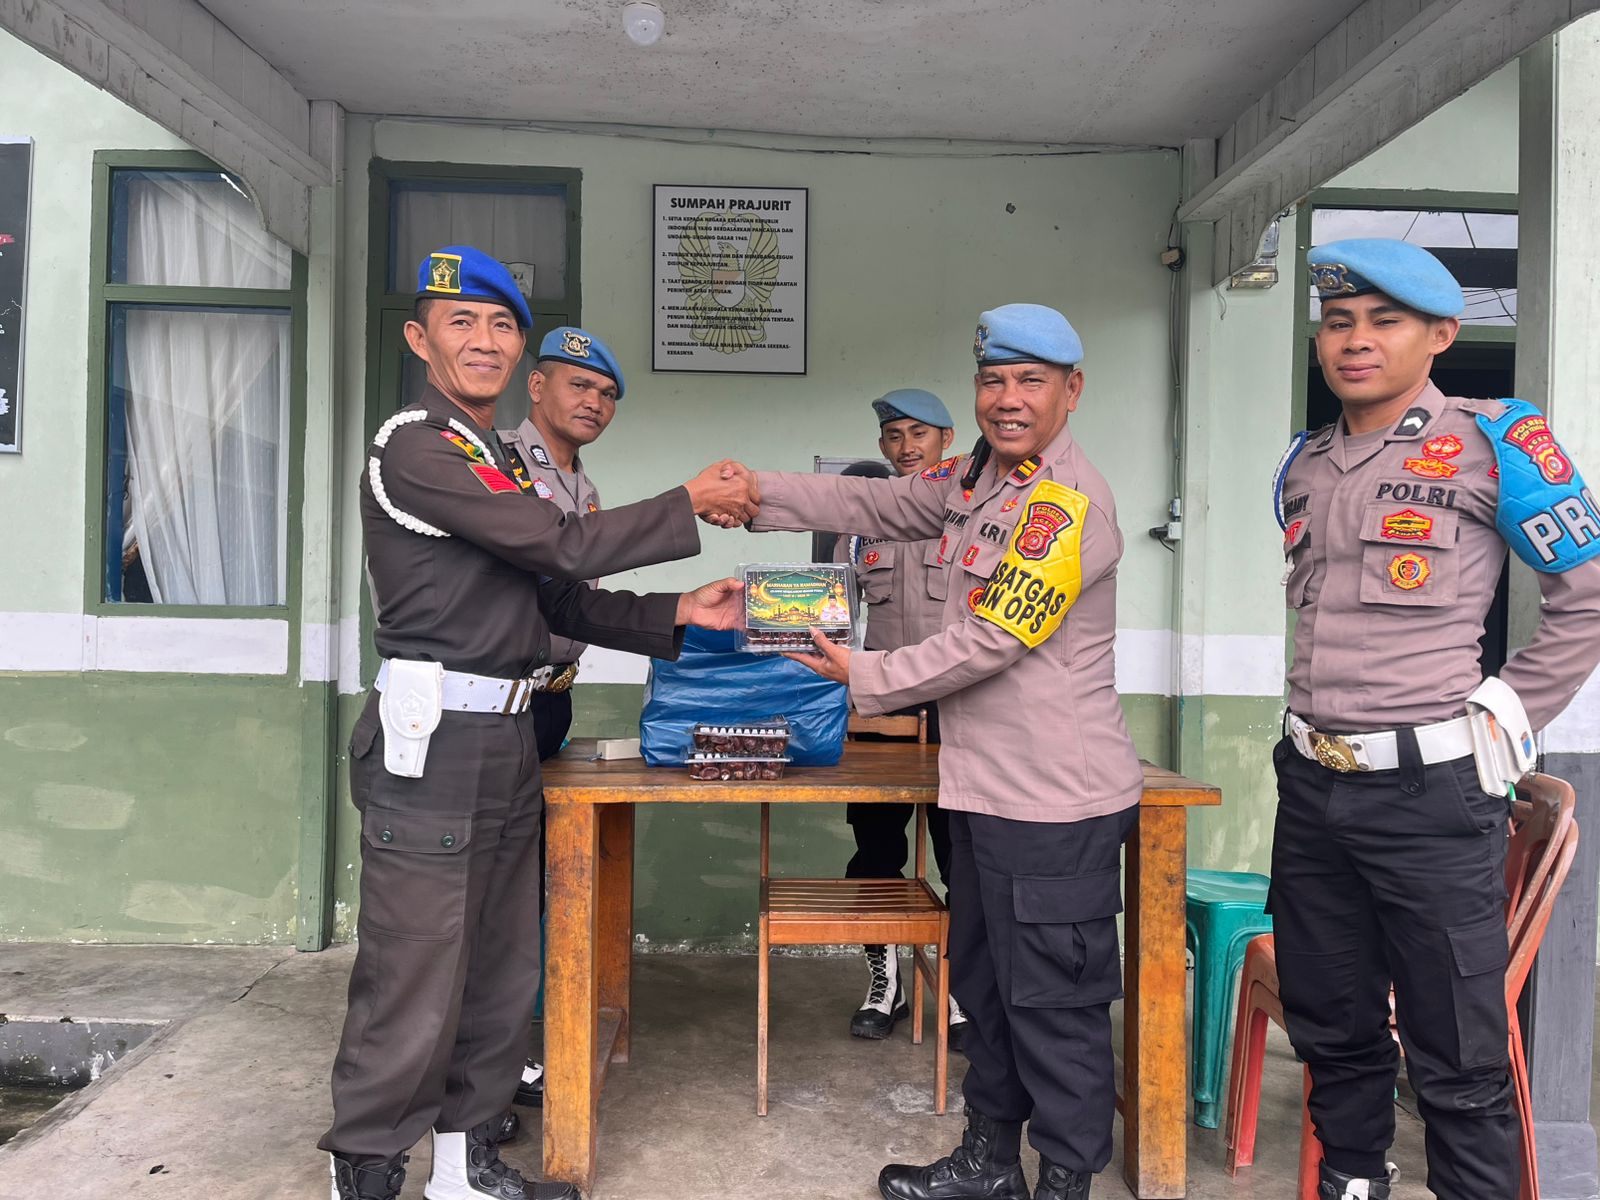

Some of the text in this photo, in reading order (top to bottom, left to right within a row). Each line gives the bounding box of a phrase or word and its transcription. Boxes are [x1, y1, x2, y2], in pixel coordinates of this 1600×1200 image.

[670, 197, 792, 211] SUMPAH PRAJURIT
[1512, 418, 1545, 439] POLRES
[1527, 435, 1549, 450] ACEH
[1376, 481, 1457, 508] POLRI
[1003, 596, 1047, 634] OPS
